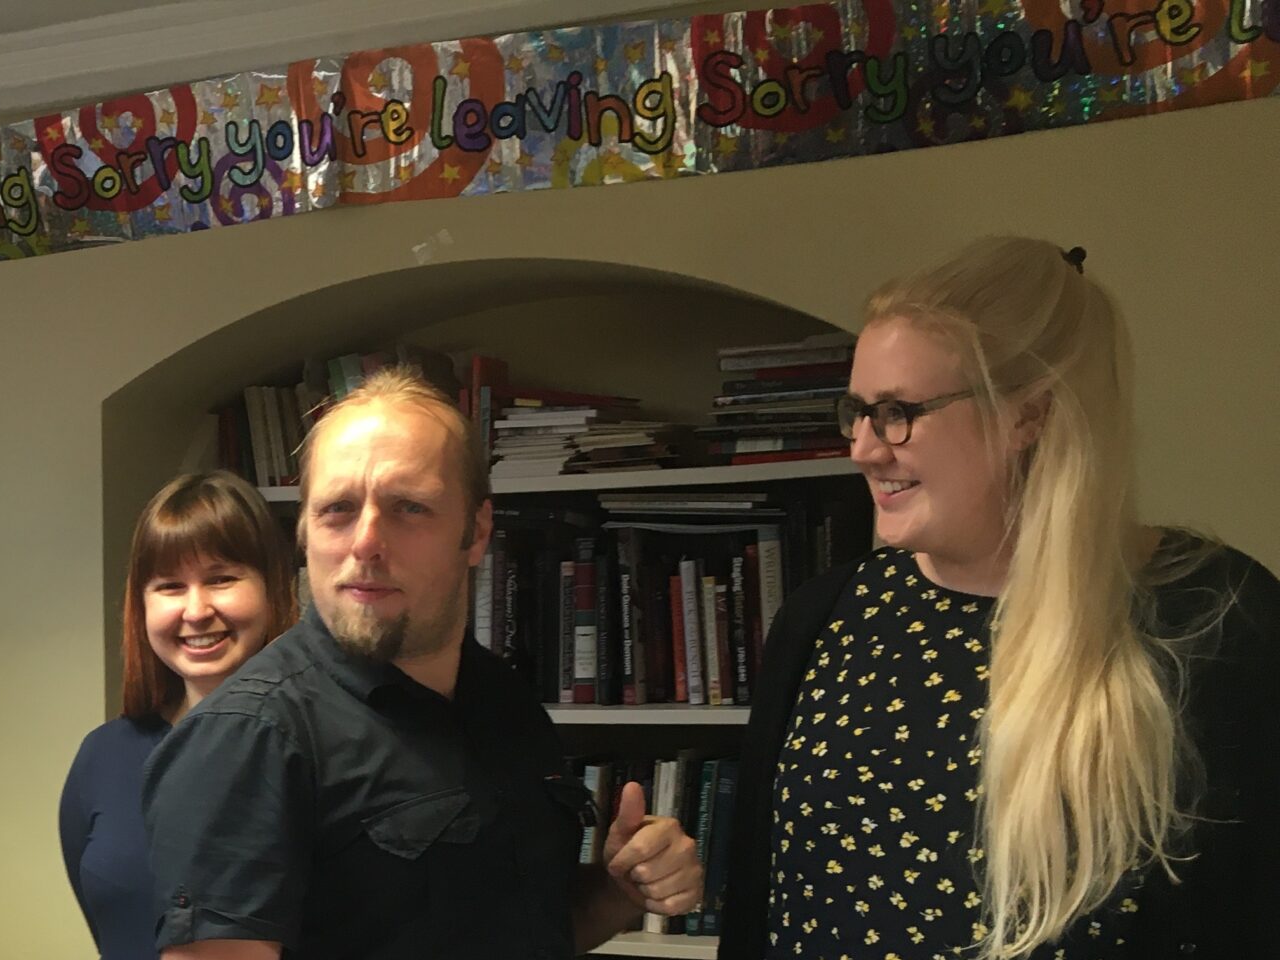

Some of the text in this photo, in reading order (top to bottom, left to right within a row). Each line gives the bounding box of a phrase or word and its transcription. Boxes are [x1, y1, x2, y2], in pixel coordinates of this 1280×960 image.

[697, 49, 910, 130] Sorry
[931, 0, 1201, 103] you're
[52, 71, 676, 212] Sorry you're leaving
